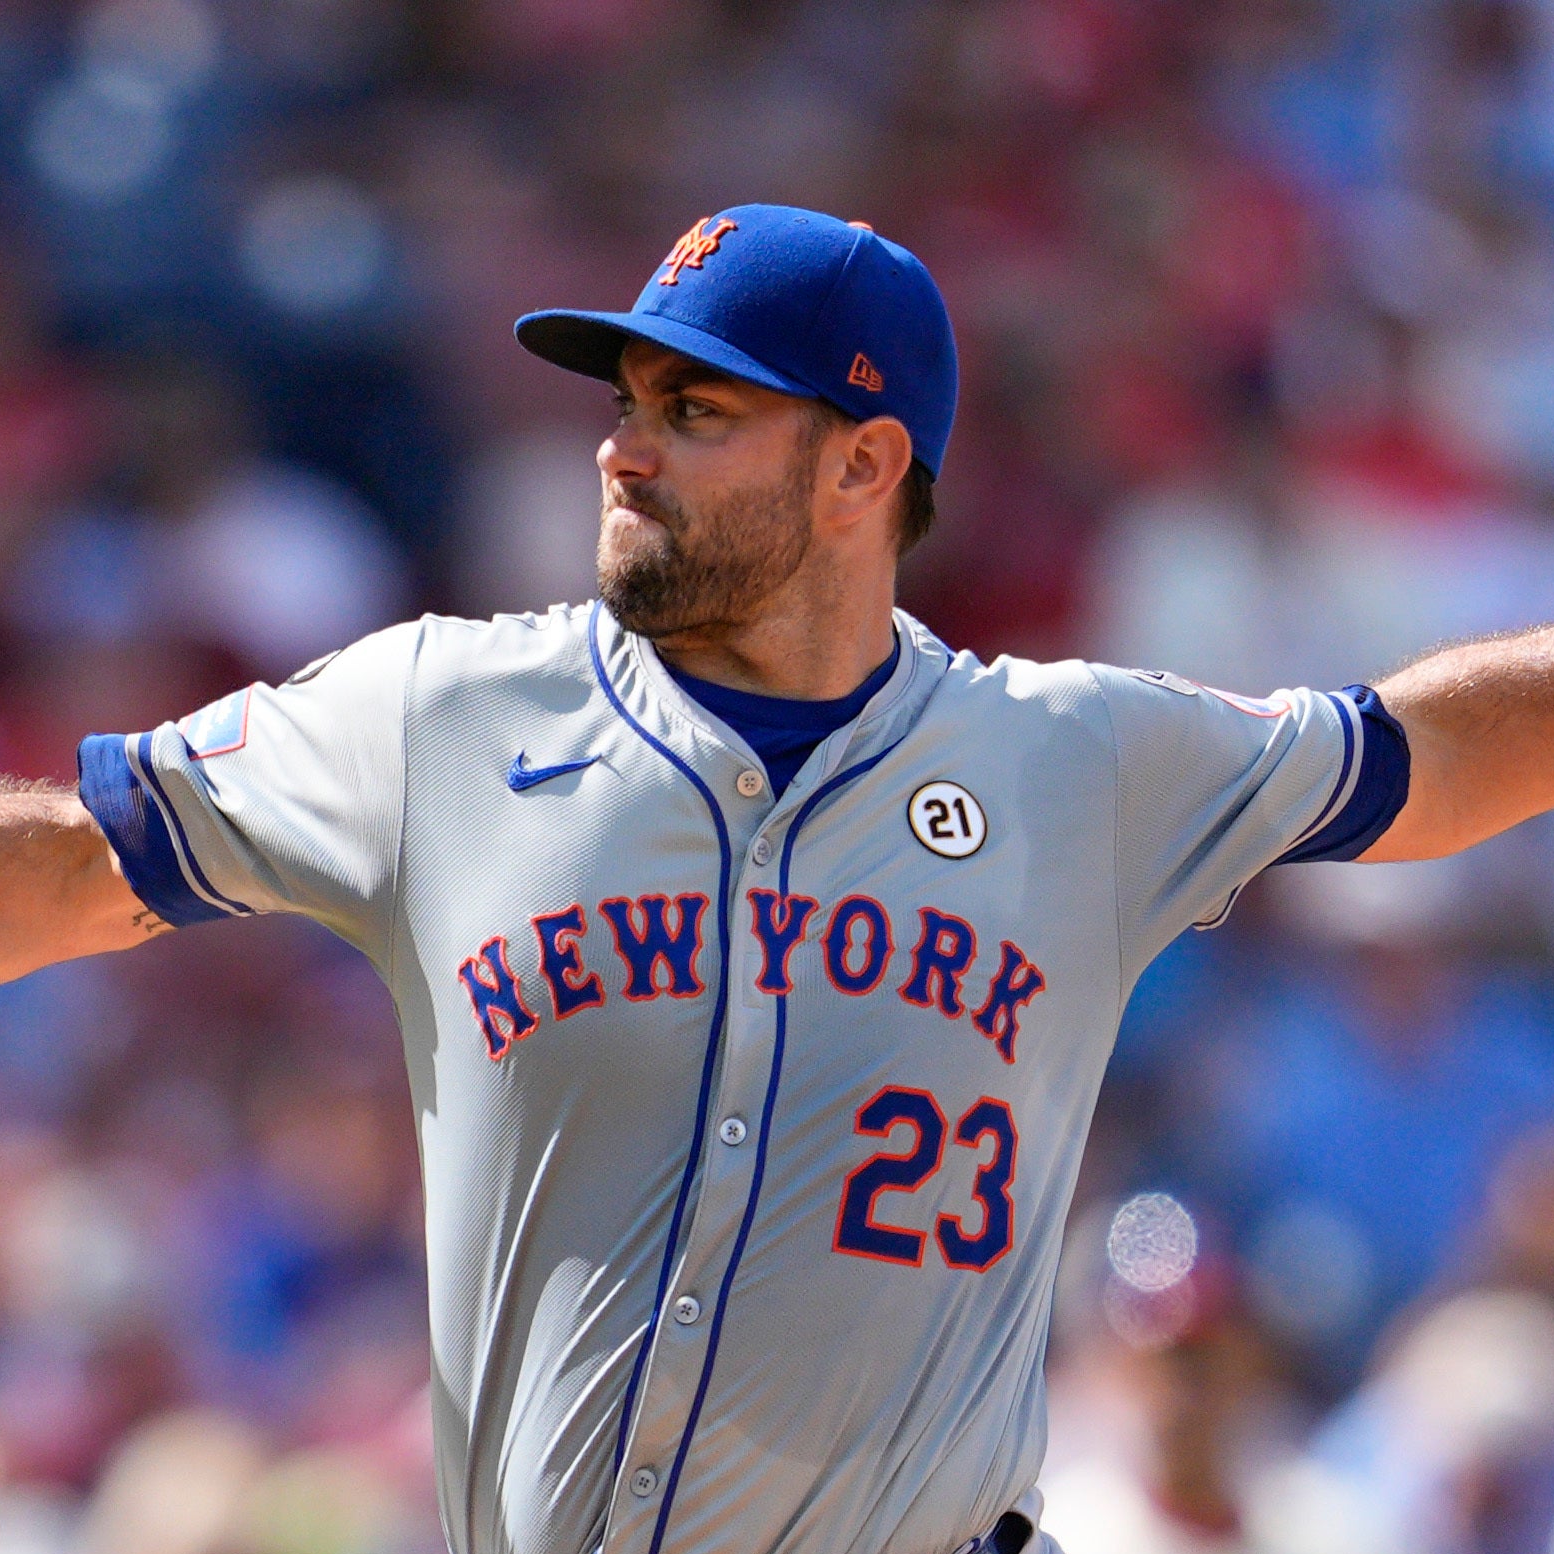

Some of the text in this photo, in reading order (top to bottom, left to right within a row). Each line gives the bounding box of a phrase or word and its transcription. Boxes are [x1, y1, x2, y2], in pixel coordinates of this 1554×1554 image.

[923, 797, 972, 838] 21
[458, 888, 1045, 1064] NEW YORK
[832, 1084, 1018, 1274] 23
